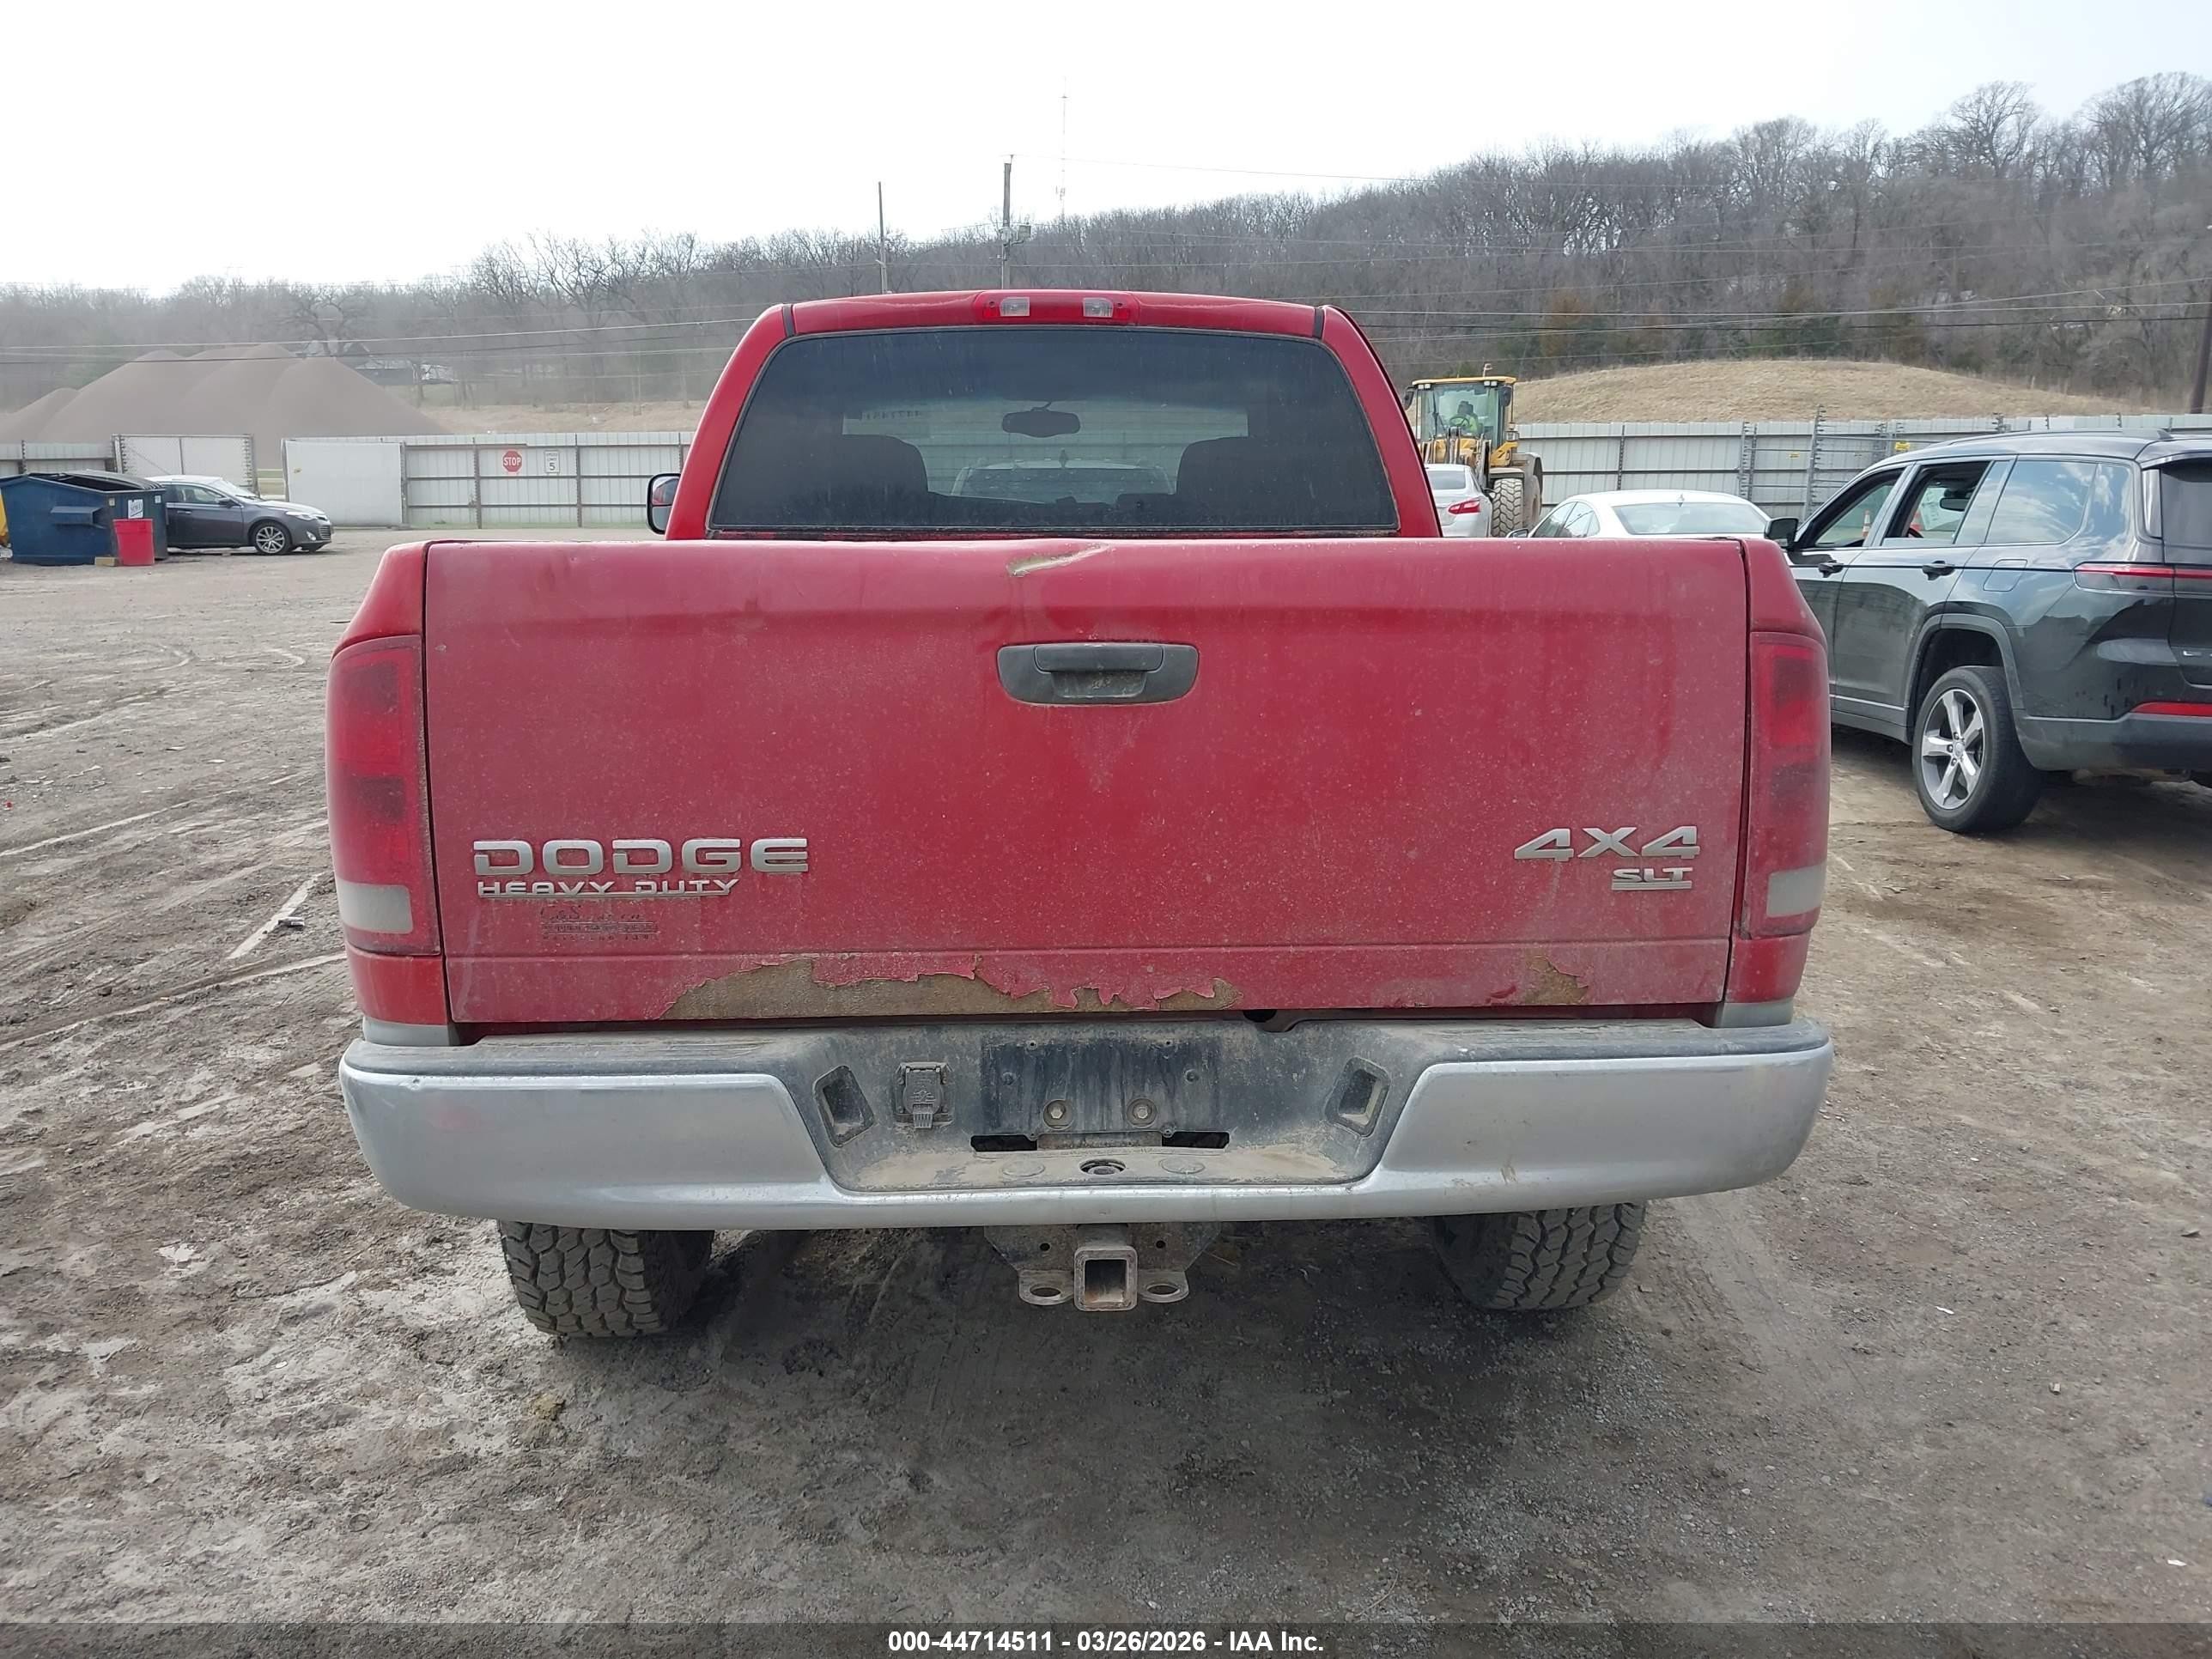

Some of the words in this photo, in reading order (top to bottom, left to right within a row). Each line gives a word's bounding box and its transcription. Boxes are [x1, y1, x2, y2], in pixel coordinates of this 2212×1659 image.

[503, 457, 522, 466] STOP
[549, 462, 556, 471] 5
[1514, 825, 1701, 862] 4X4
[473, 838, 809, 875] DODGE
[1612, 867, 1693, 884] SLT
[477, 880, 616, 896] HEAVY
[635, 878, 740, 895] DUTY
